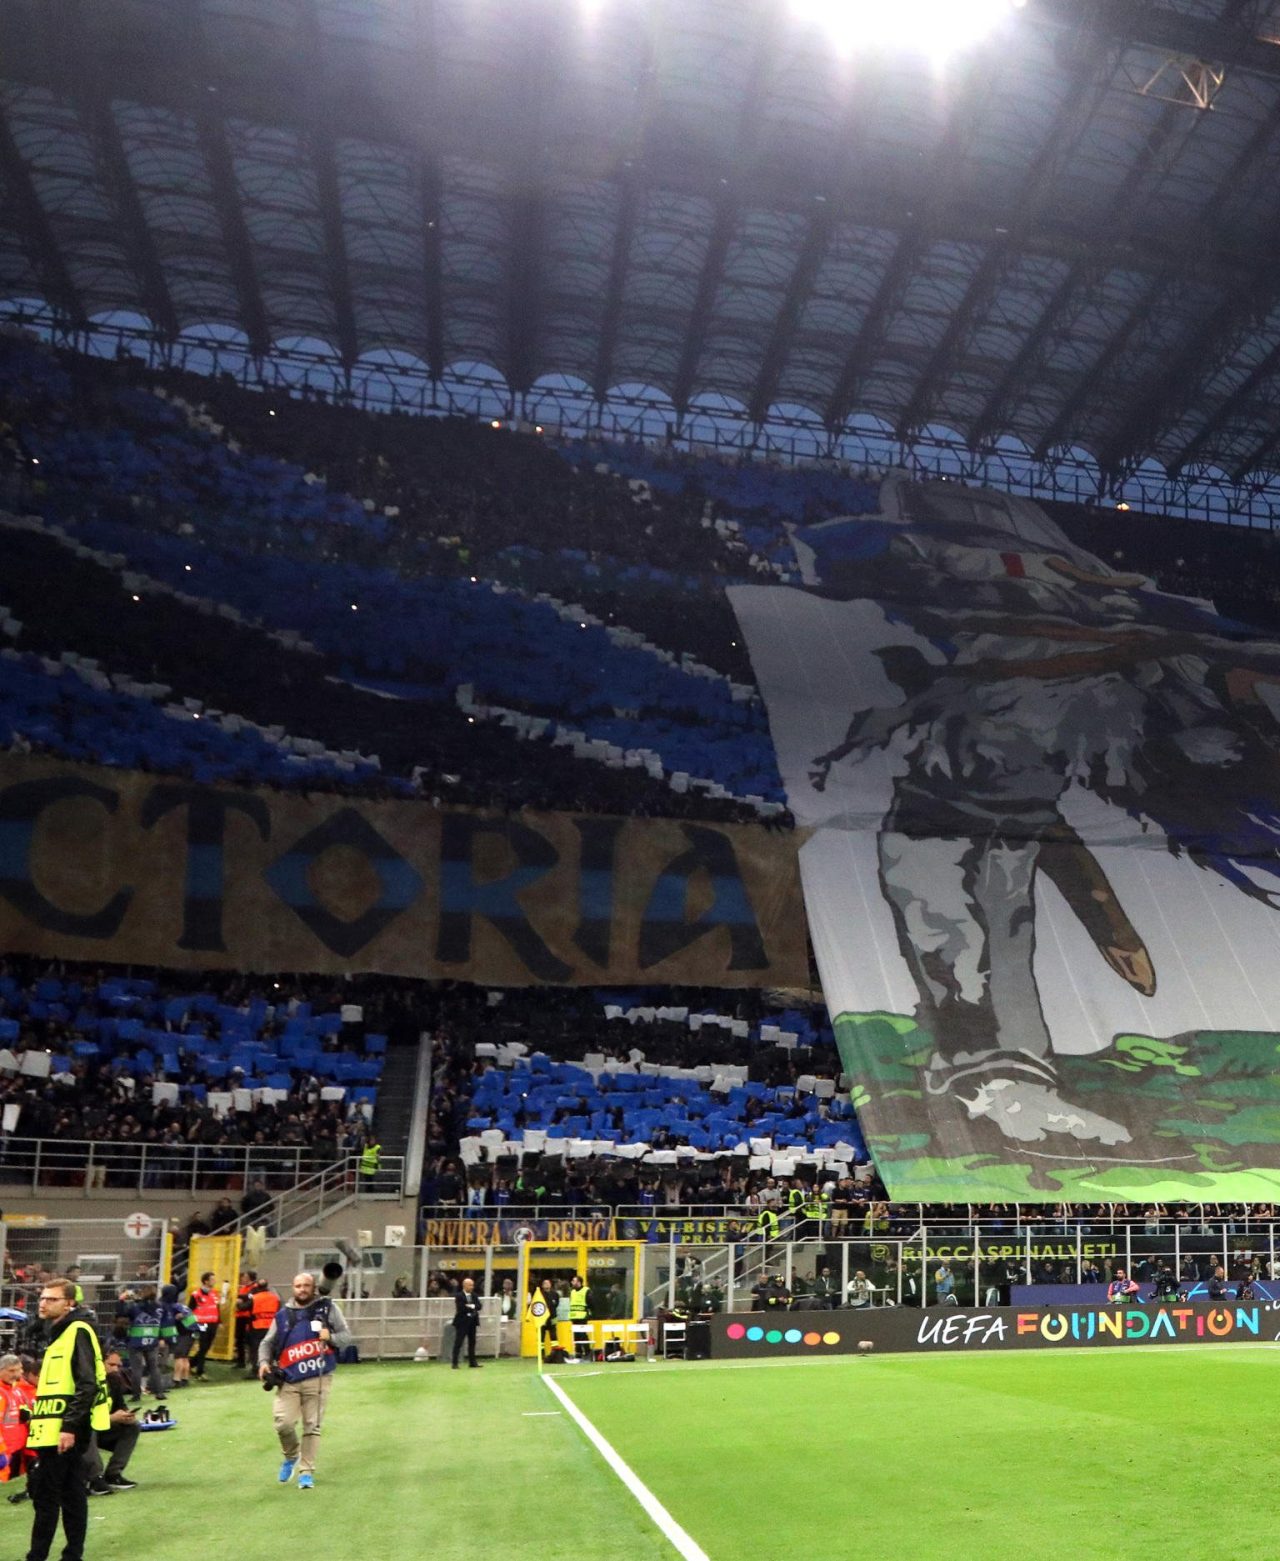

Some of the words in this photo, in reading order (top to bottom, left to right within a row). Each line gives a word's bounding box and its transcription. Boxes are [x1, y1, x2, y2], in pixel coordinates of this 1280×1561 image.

[424, 1219, 500, 1248] RIVIERA
[547, 1219, 617, 1247] BERICA
[681, 1234, 726, 1244] PRAT
[917, 1315, 1008, 1344] UEFA
[1017, 1308, 1259, 1342] FOUNDATION
